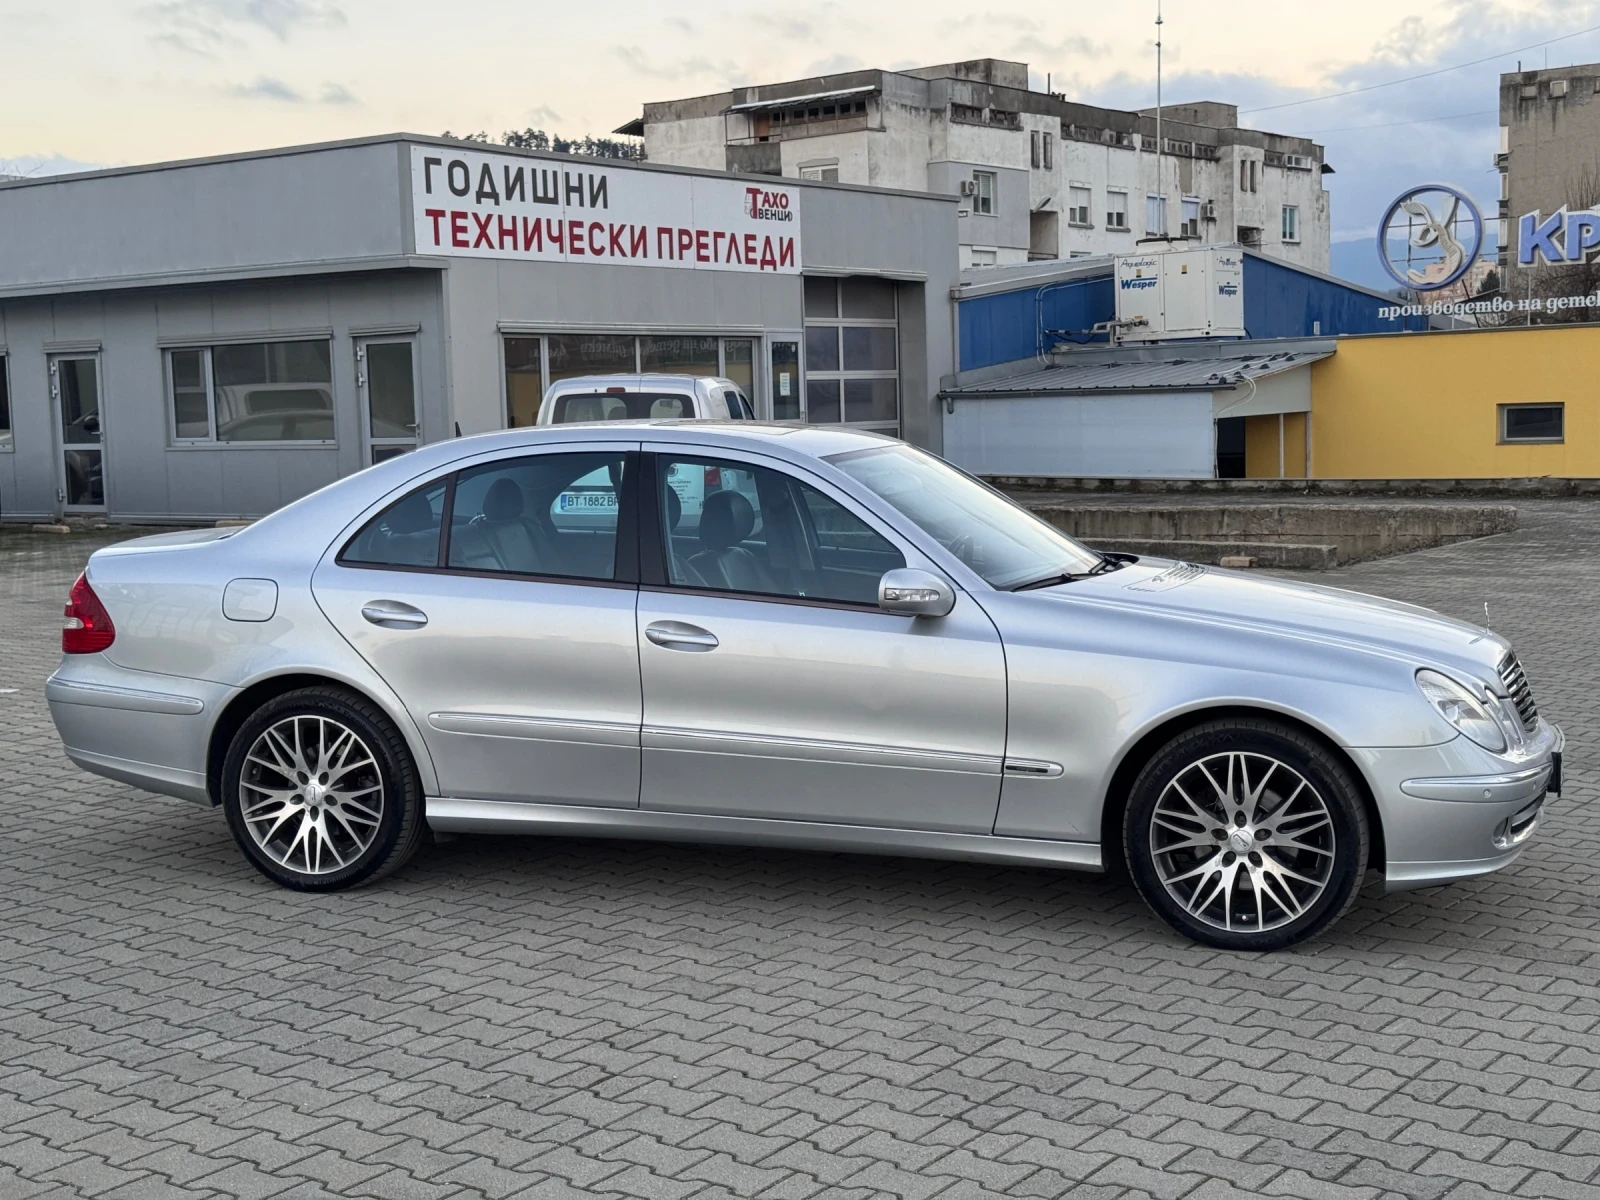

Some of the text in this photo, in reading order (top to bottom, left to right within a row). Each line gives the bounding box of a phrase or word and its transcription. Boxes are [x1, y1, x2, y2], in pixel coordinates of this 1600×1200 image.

[424, 156, 609, 210] ГОДИШНИ
[745, 187, 789, 219] ТАХО
[425, 208, 795, 271] ТЕХНИЧЕСКИ ПРЕГЛЕДИ
[1121, 278, 1158, 290] Wesper
[1218, 285, 1238, 297] Wesper
[1378, 296, 1513, 321] производство
[1517, 297, 1543, 311] на
[567, 496, 581, 507] BT
[583, 496, 606, 506] 1882
